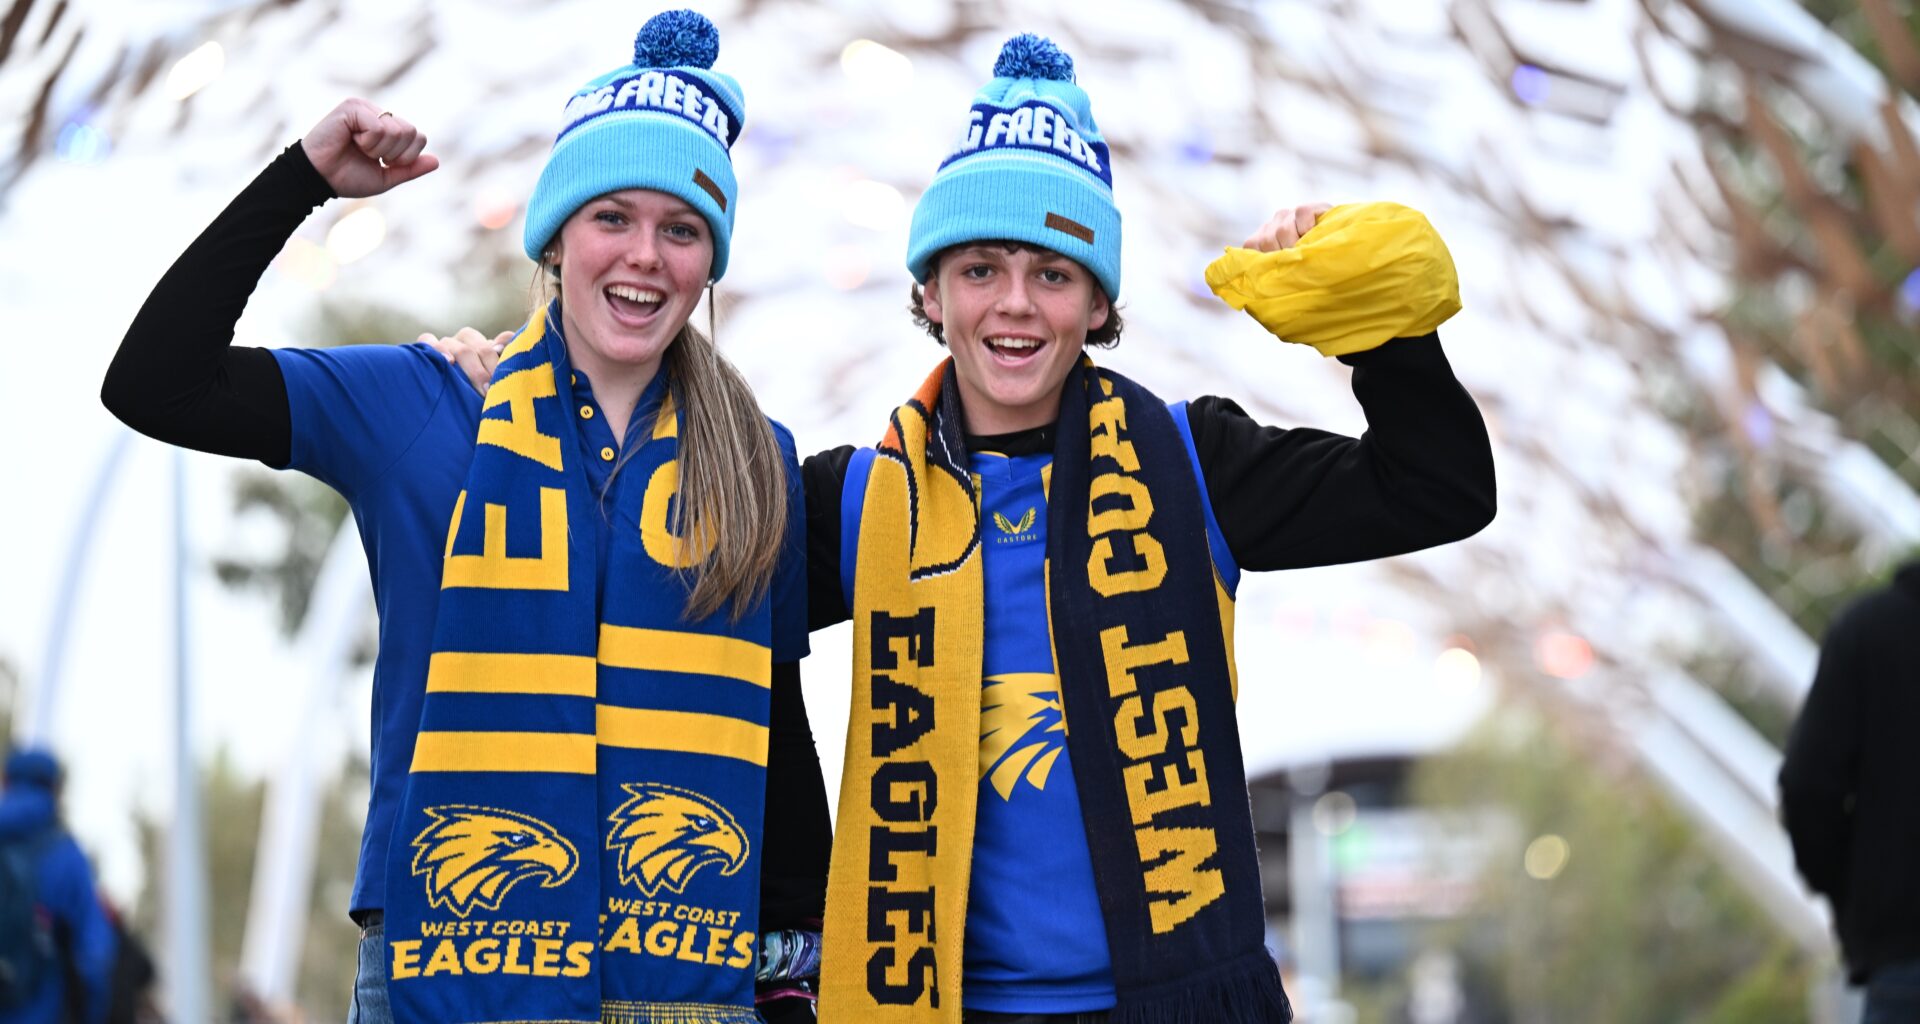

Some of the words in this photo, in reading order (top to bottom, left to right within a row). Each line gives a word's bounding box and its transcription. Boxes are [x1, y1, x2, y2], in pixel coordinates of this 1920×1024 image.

[1087, 377, 1169, 598] COA
[867, 606, 940, 1009] EAGLES
[1100, 624, 1225, 935] WEST
[389, 937, 595, 981] EAGLES
[421, 920, 487, 937] WEST
[491, 920, 570, 937] COAST
[608, 897, 671, 917] WEST
[673, 904, 741, 927] COAST
